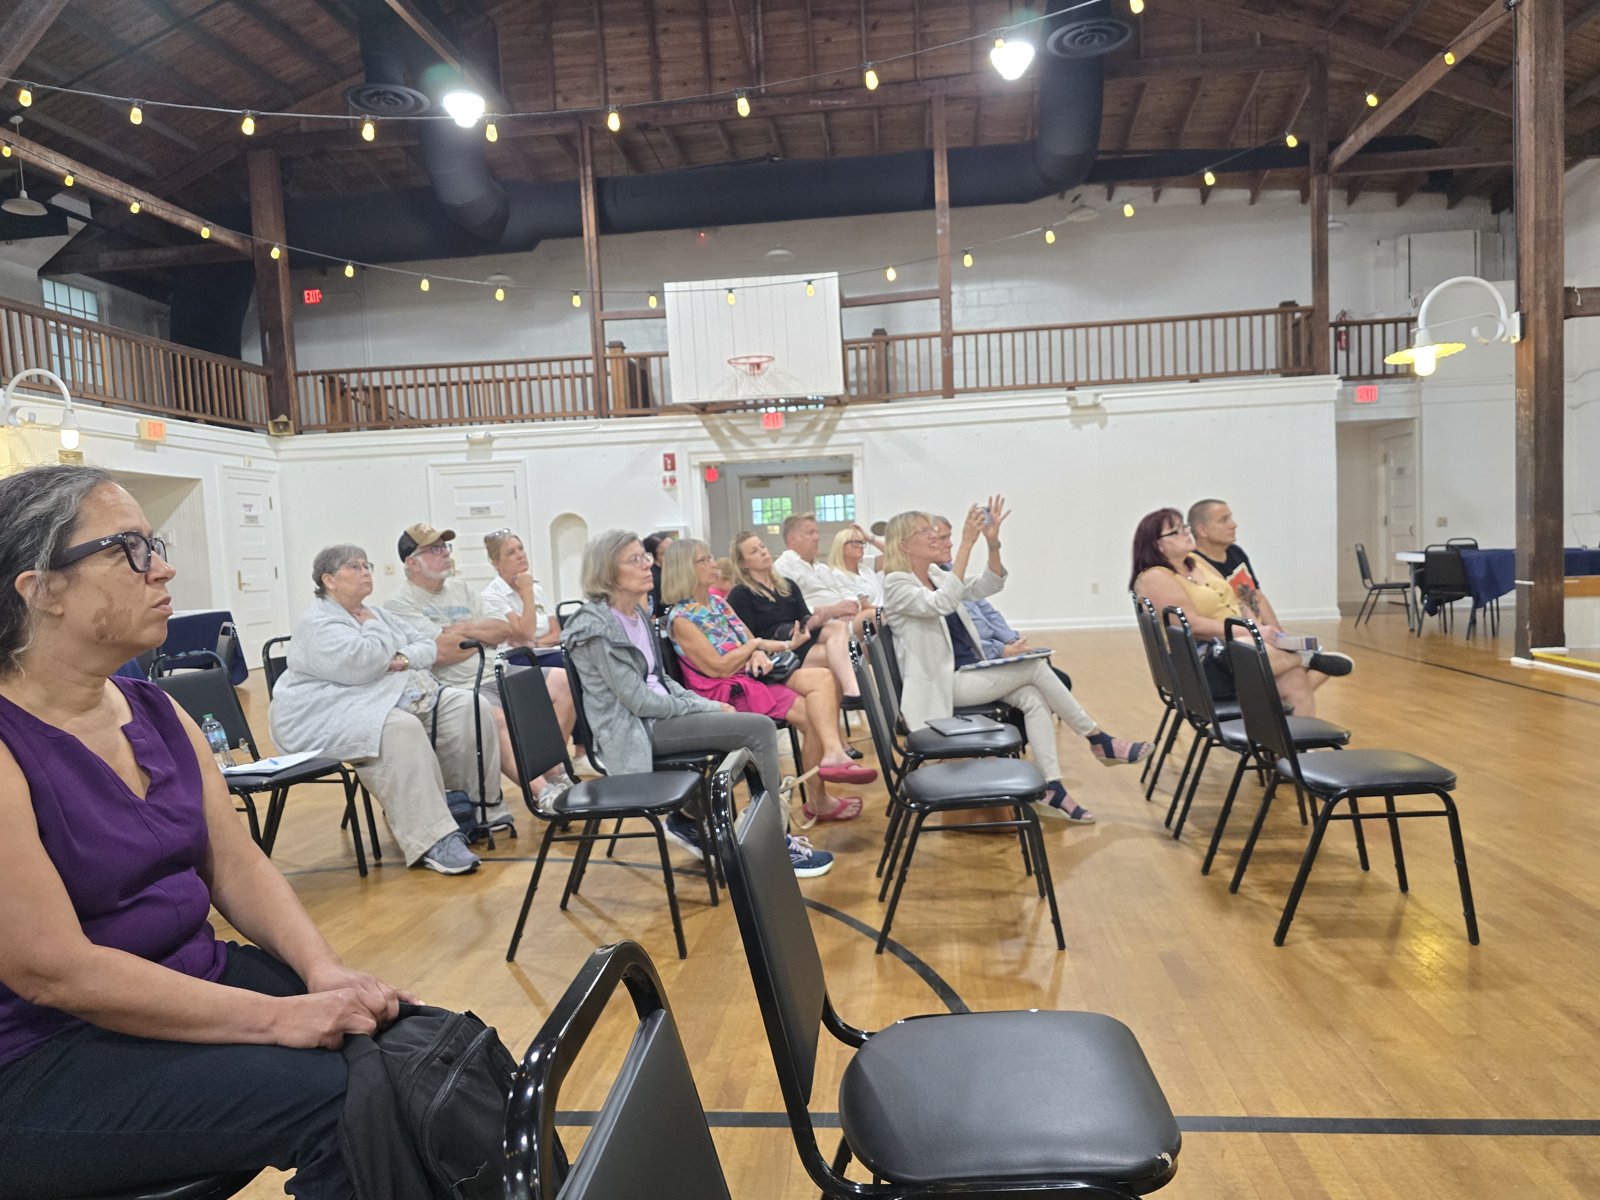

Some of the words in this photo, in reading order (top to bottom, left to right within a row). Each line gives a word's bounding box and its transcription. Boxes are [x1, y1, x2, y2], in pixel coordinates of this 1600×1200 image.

[304, 289, 320, 304] EXIT
[763, 412, 782, 429] EXIT
[148, 421, 164, 438] EXIT
